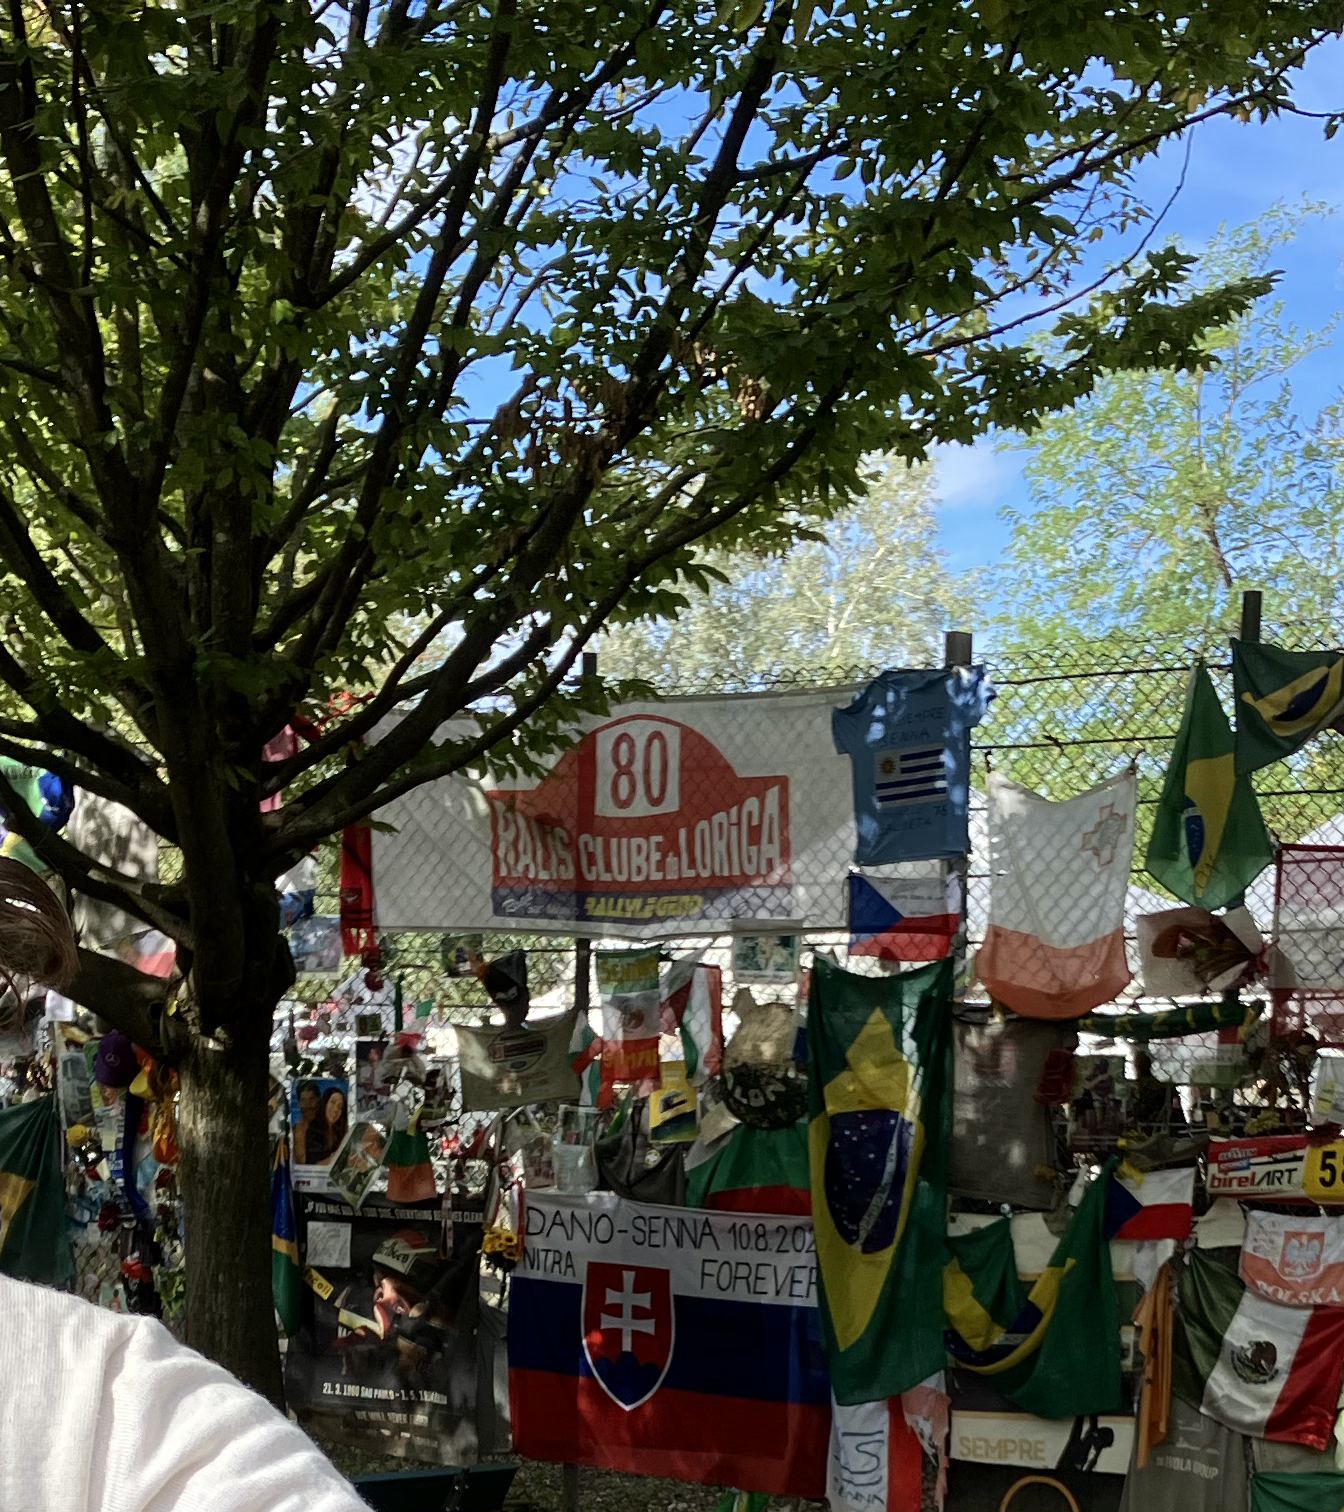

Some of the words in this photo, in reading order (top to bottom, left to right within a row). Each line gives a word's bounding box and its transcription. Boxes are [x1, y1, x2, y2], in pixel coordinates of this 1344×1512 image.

[611, 730, 668, 809] 80
[578, 832, 664, 882] CLUBE
[524, 1206, 720, 1251] DANO-SENNA
[523, 1247, 576, 1278] NITRA
[1255, 1280, 1342, 1304] POLSKA
[958, 1436, 1046, 1462] SEMPRE
